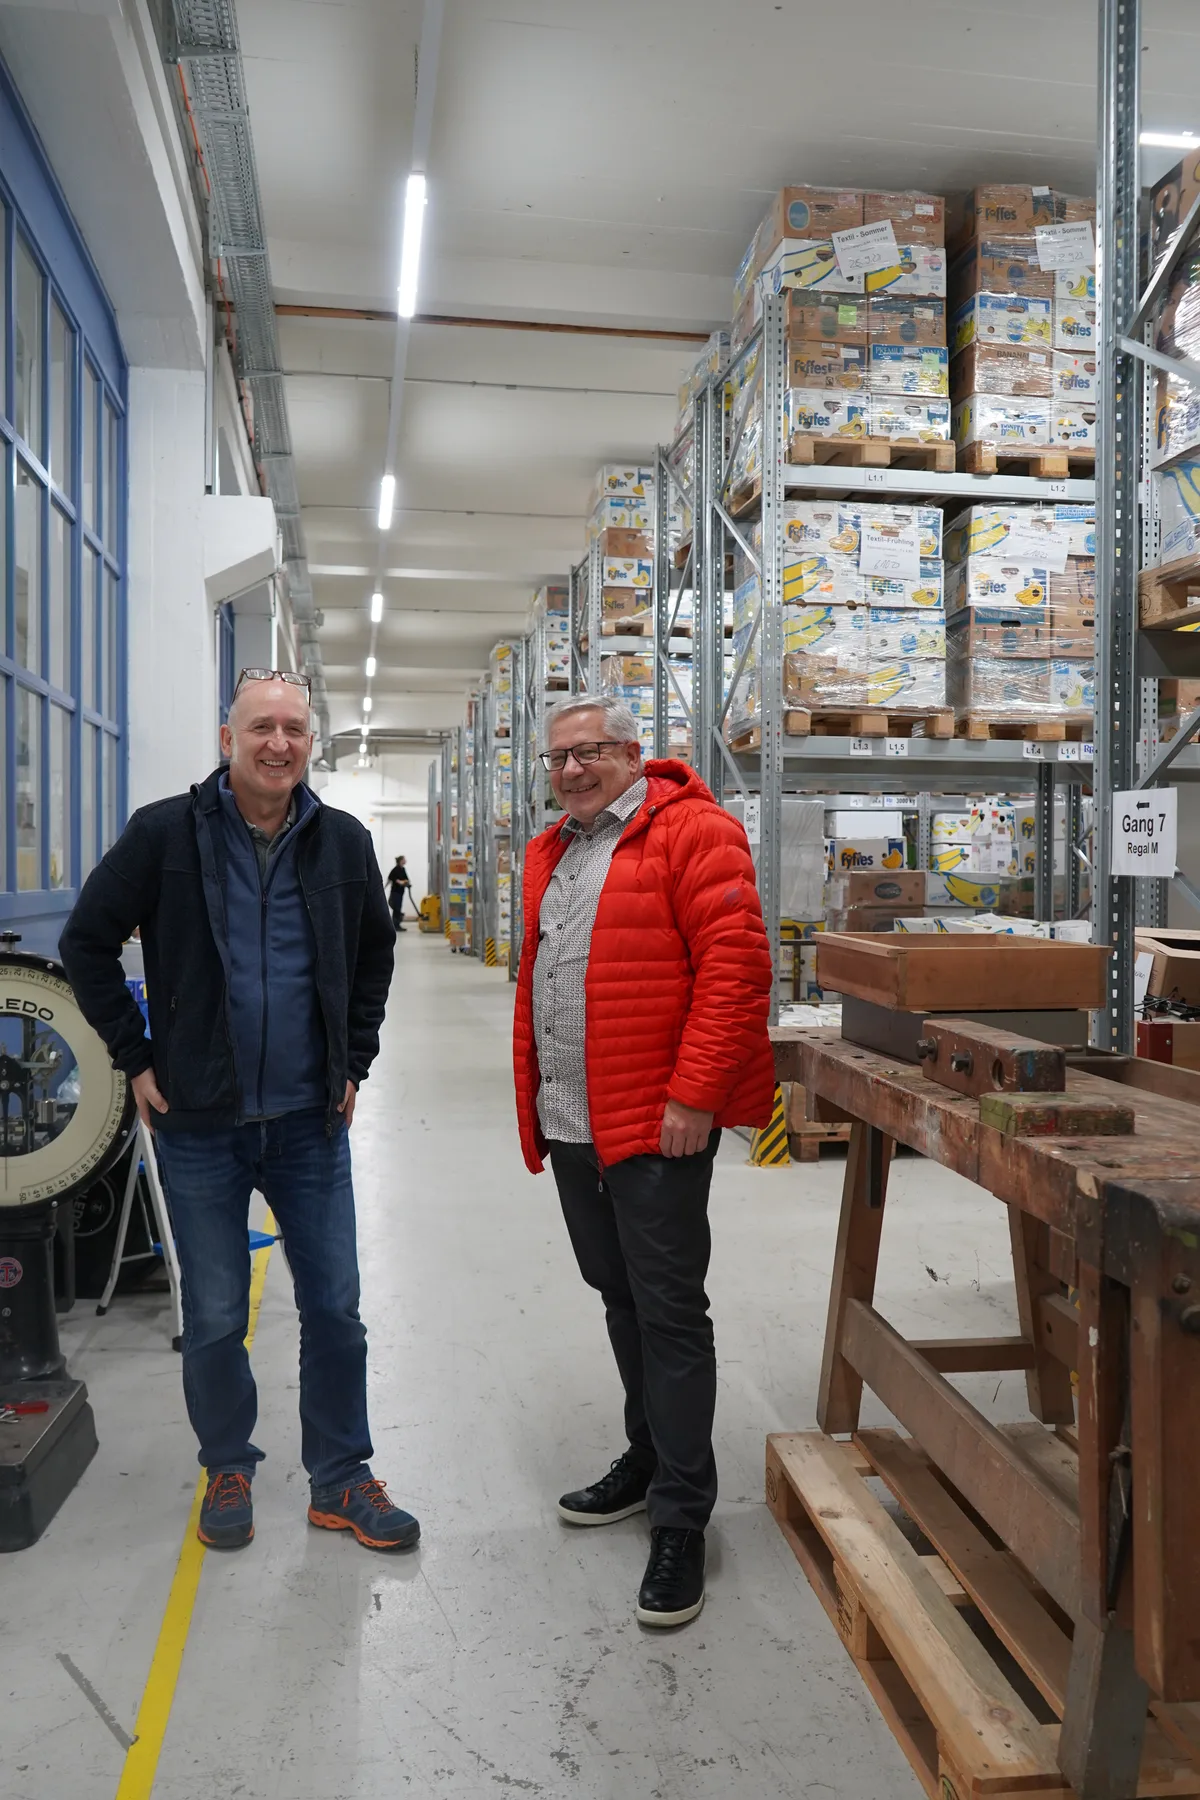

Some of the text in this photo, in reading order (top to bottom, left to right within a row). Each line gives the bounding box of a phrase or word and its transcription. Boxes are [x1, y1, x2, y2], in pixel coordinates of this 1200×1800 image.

[837, 233, 855, 243] Textil
[860, 226, 887, 238] Sommer
[1062, 227, 1087, 235] Sommer
[868, 474, 883, 482] L1.1
[1051, 484, 1066, 492] L1.2
[852, 742, 869, 751] L1.3
[889, 743, 905, 751] L1.5
[1026, 747, 1041, 755] L1.4
[1122, 813, 1166, 837] Gang 7
[1127, 842, 1159, 857] Regal M
[0, 998, 54, 1022] EDO
